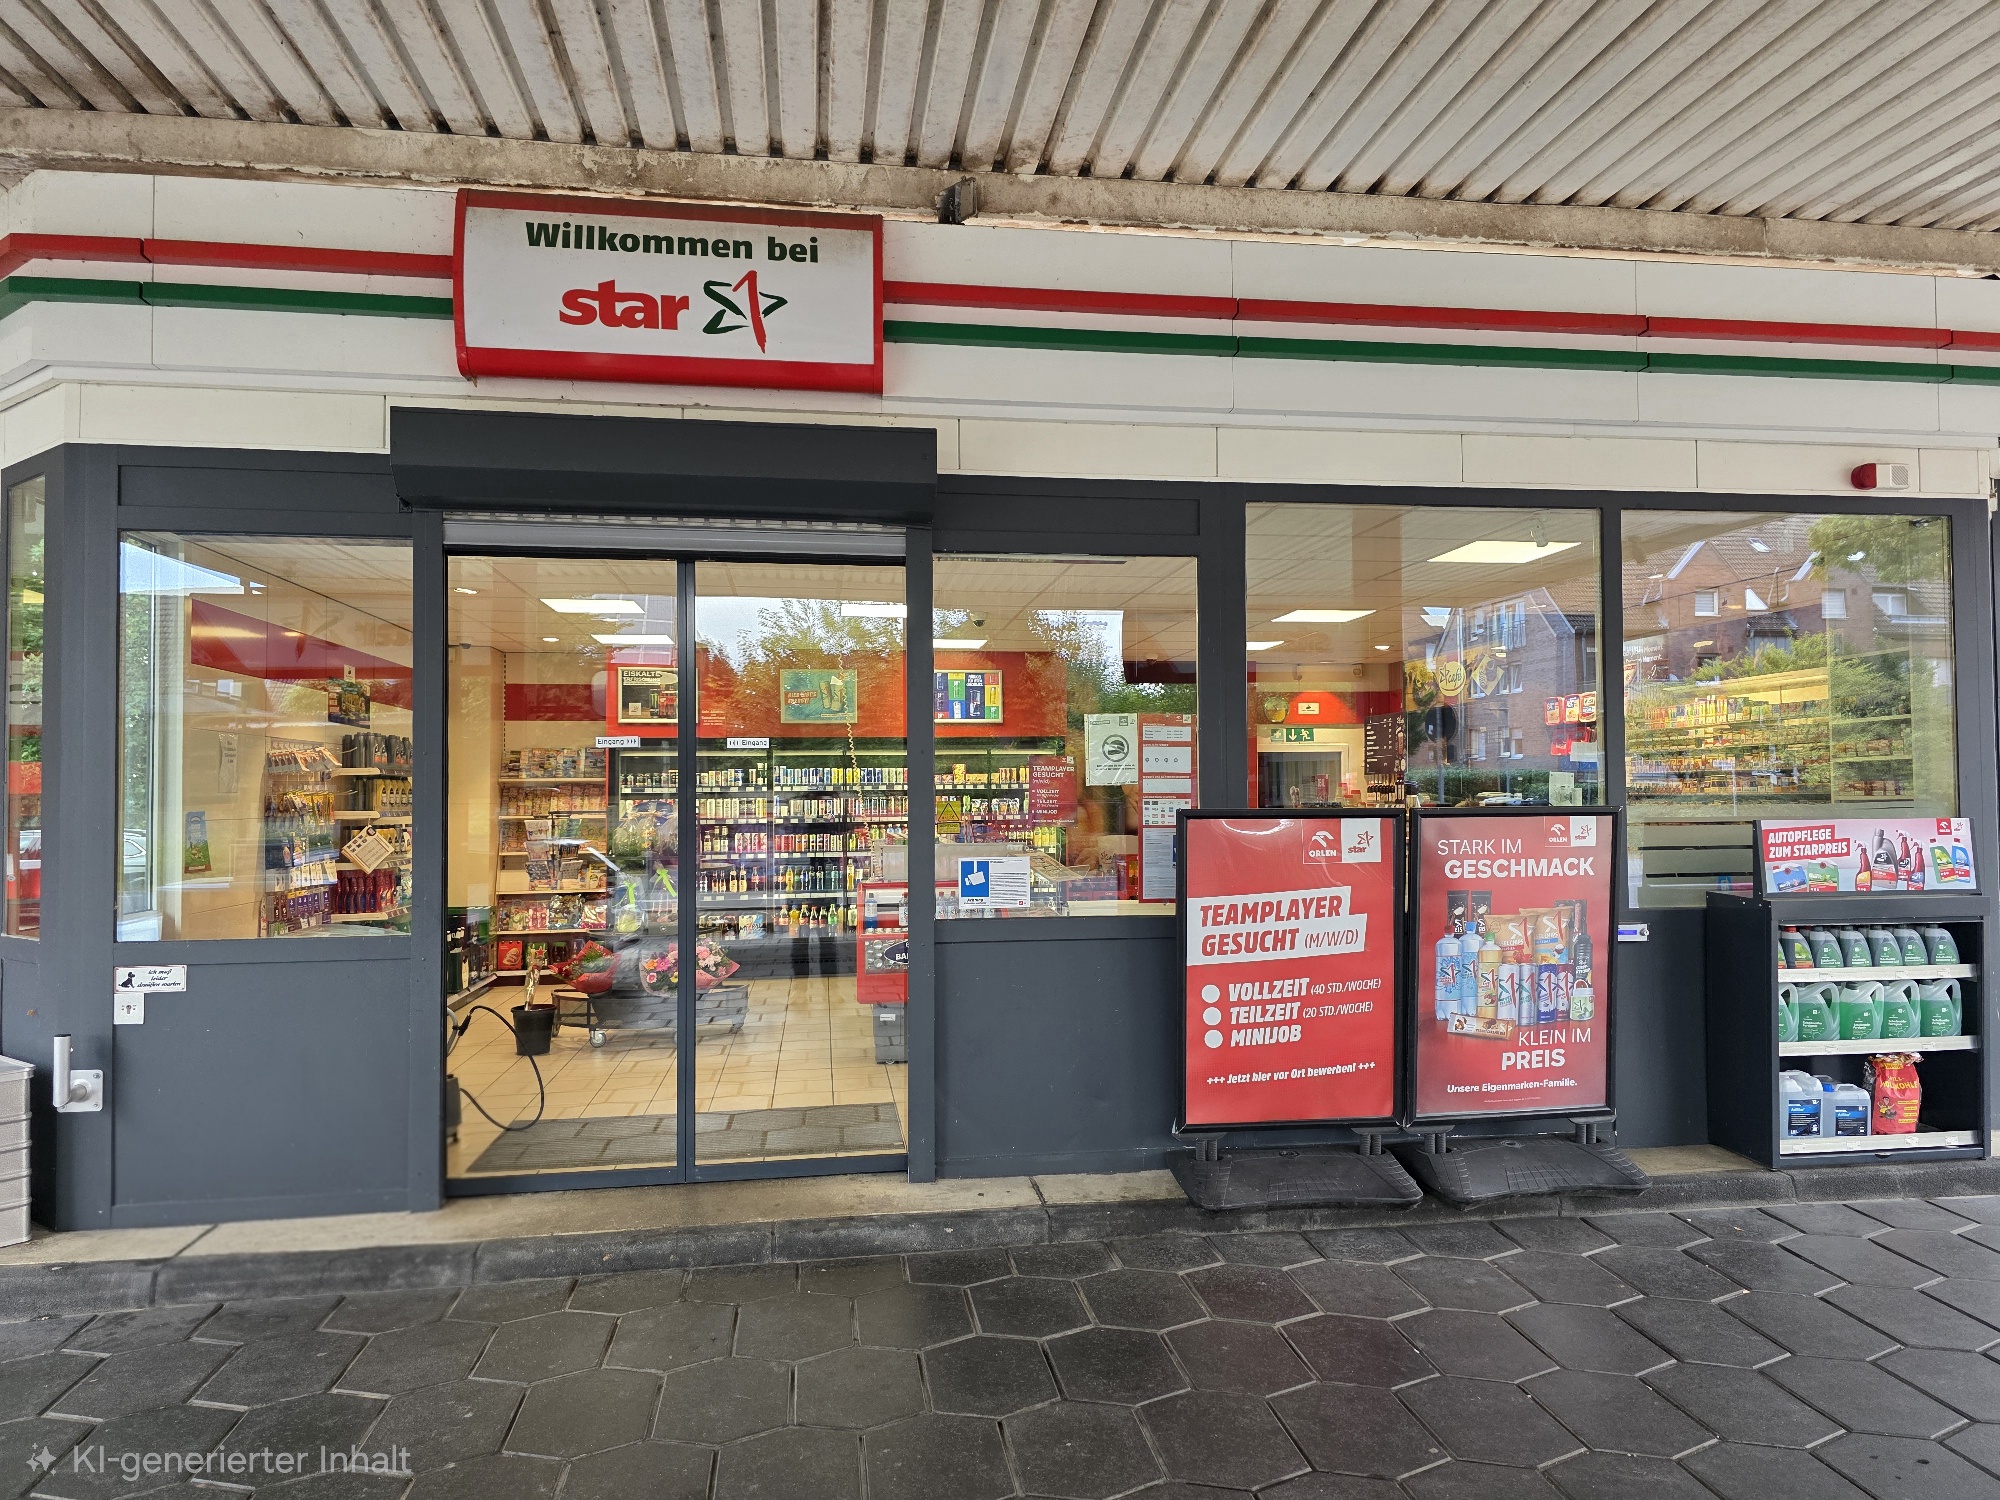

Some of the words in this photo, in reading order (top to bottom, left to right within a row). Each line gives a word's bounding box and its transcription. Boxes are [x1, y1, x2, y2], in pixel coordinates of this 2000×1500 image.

[526, 221, 753, 260] Willkommen
[767, 236, 819, 264] bei
[559, 279, 689, 331] star
[597, 739, 625, 747] Eingang
[741, 739, 768, 747] Eingang
[1437, 838, 1497, 856] STARK
[1501, 838, 1522, 854] IM
[1574, 833, 1588, 841] star
[1768, 828, 1832, 845] AUTOPFLEGE
[1308, 849, 1337, 858] ORLEN
[1347, 845, 1367, 854] star
[1768, 844, 1792, 859] ZUM
[1793, 840, 1848, 857] STARPREIS
[1444, 856, 1595, 879] GESCHMACK
[1200, 895, 1343, 928] TEAMPLAYER
[1202, 928, 1300, 957] GESUCHT
[1304, 928, 1359, 949] (M/W/D)
[1229, 977, 1310, 1002] VOLLZEIT
[1310, 982, 1325, 996] (40
[1326, 977, 1382, 994] STD./WOCHE)
[1230, 1001, 1301, 1025] TEILZEIT
[1302, 1006, 1317, 1019] (20
[1319, 1001, 1374, 1017] STD./WOCHE)
[1230, 1024, 1302, 1047] MINIJOB
[1518, 1029, 1566, 1047] KLEIN
[1571, 1027, 1591, 1043] IM
[1501, 1048, 1566, 1071] PREIS
[1227, 1073, 1251, 1085] Jetzt
[1252, 1070, 1272, 1082] hier
[1273, 1069, 1290, 1081] vor
[1291, 1067, 1306, 1079] Ort
[1307, 1062, 1357, 1078] bewerben!
[1447, 1083, 1480, 1093] Unsere
[1482, 1077, 1578, 1093] Eigenmarken-Familie.
